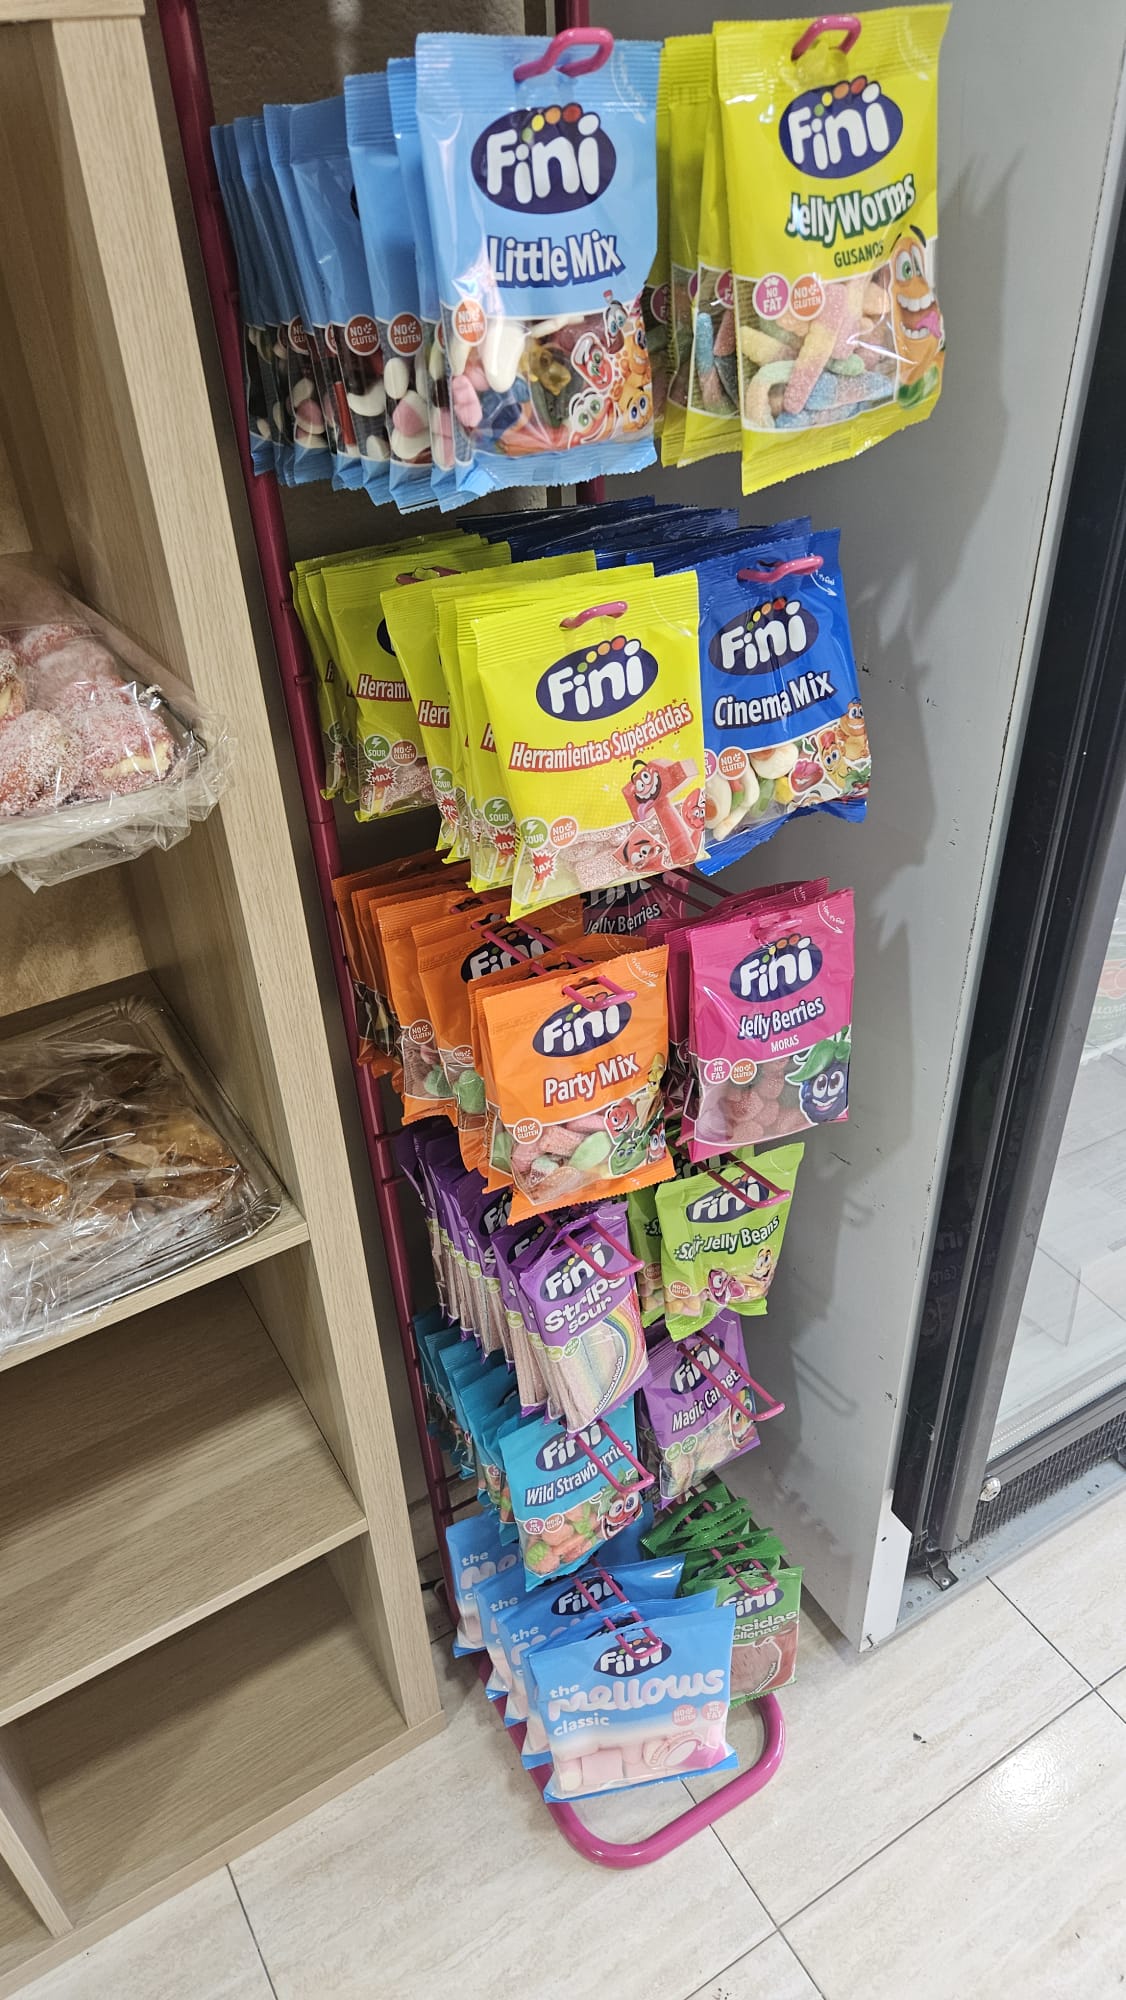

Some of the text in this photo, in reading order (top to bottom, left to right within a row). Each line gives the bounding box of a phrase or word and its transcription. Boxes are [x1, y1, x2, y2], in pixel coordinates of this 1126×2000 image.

[787, 82, 890, 171] Fini
[486, 113, 600, 204] Fini
[787, 174, 916, 245] Jelly Worms
[487, 229, 624, 284] Little Mix
[766, 286, 779, 298] NO
[794, 285, 809, 298] NO
[763, 296, 783, 313] FAT
[793, 296, 822, 310] GLUTEN
[457, 311, 473, 323] NO
[350, 327, 364, 337] NO
[394, 325, 407, 336] NO
[458, 321, 484, 335] GLUTEN
[351, 334, 378, 347] GLUTEN
[394, 334, 421, 346] GLUTEN
[720, 601, 807, 669] Fini
[547, 639, 644, 715] Fini
[714, 671, 836, 728] Cinema Mix
[509, 701, 693, 770] Herramientas Superácidas
[367, 749, 387, 758] SOUR
[393, 746, 404, 754] NO
[393, 752, 415, 761] GLUTEN
[720, 756, 732, 766] NO
[721, 762, 746, 773] GLUTEN
[371, 771, 393, 784] MAX
[488, 812, 510, 823] SOUR
[552, 825, 564, 836] NO
[553, 830, 575, 842] GLUTEN
[617, 902, 661, 933] Berries
[740, 937, 813, 997] Fini
[738, 996, 825, 1041] Jelly Berries
[411, 1026, 422, 1035] NO
[543, 1001, 620, 1053] Fini
[412, 1031, 432, 1040] GLUTEN
[770, 1035, 799, 1053] MORAS
[711, 1071, 725, 1081] FAT
[713, 1065, 723, 1073] NO
[733, 1065, 744, 1074] NO
[733, 1070, 753, 1079] GLUTEN
[545, 1054, 640, 1106] Party Mix
[517, 1125, 528, 1134] NO
[517, 1130, 539, 1140] GLUTEN
[692, 1176, 760, 1221] Fini
[703, 1234, 738, 1252] Jelly
[741, 1217, 779, 1245] Beans
[546, 1243, 606, 1301] Fini
[544, 1274, 626, 1333] Strips
[568, 1296, 612, 1334] sour
[672, 1401, 706, 1432] Magic
[526, 1482, 554, 1506] Wild
[461, 1552, 489, 1567] the
[489, 1597, 518, 1612] the
[510, 1626, 539, 1643] the
[547, 1669, 725, 1721] mellows
[550, 1684, 579, 1699] the
[553, 1712, 610, 1737] classic
